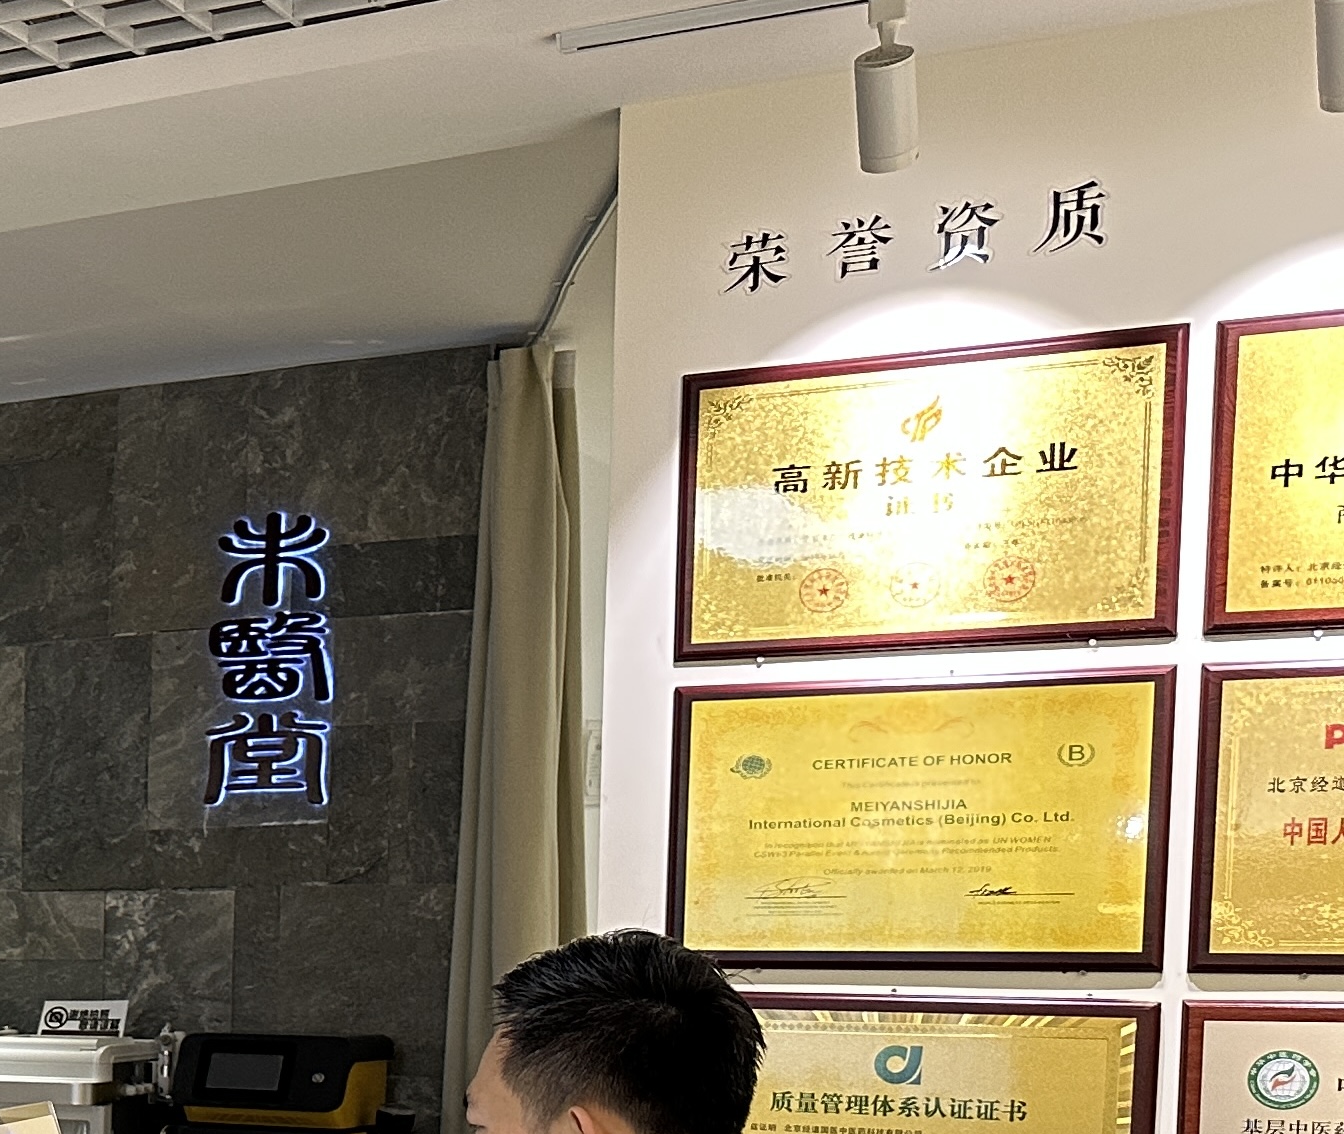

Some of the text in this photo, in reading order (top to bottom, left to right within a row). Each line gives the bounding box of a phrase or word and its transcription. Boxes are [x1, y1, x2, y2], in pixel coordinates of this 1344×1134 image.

[725, 180, 1107, 293] 荣誉资质
[772, 442, 1079, 494] 高新技术企业
[812, 752, 1012, 771] CERTIFICATE OF HONOR
[851, 799, 968, 812] MEIYANSHIJIA
[748, 817, 846, 830] International
[850, 815, 934, 829] Cosmetics
[938, 813, 1006, 828] (Beijing)
[1043, 811, 1075, 823] Ltd.
[770, 1090, 1028, 1123] 质量管理体系认证证书
